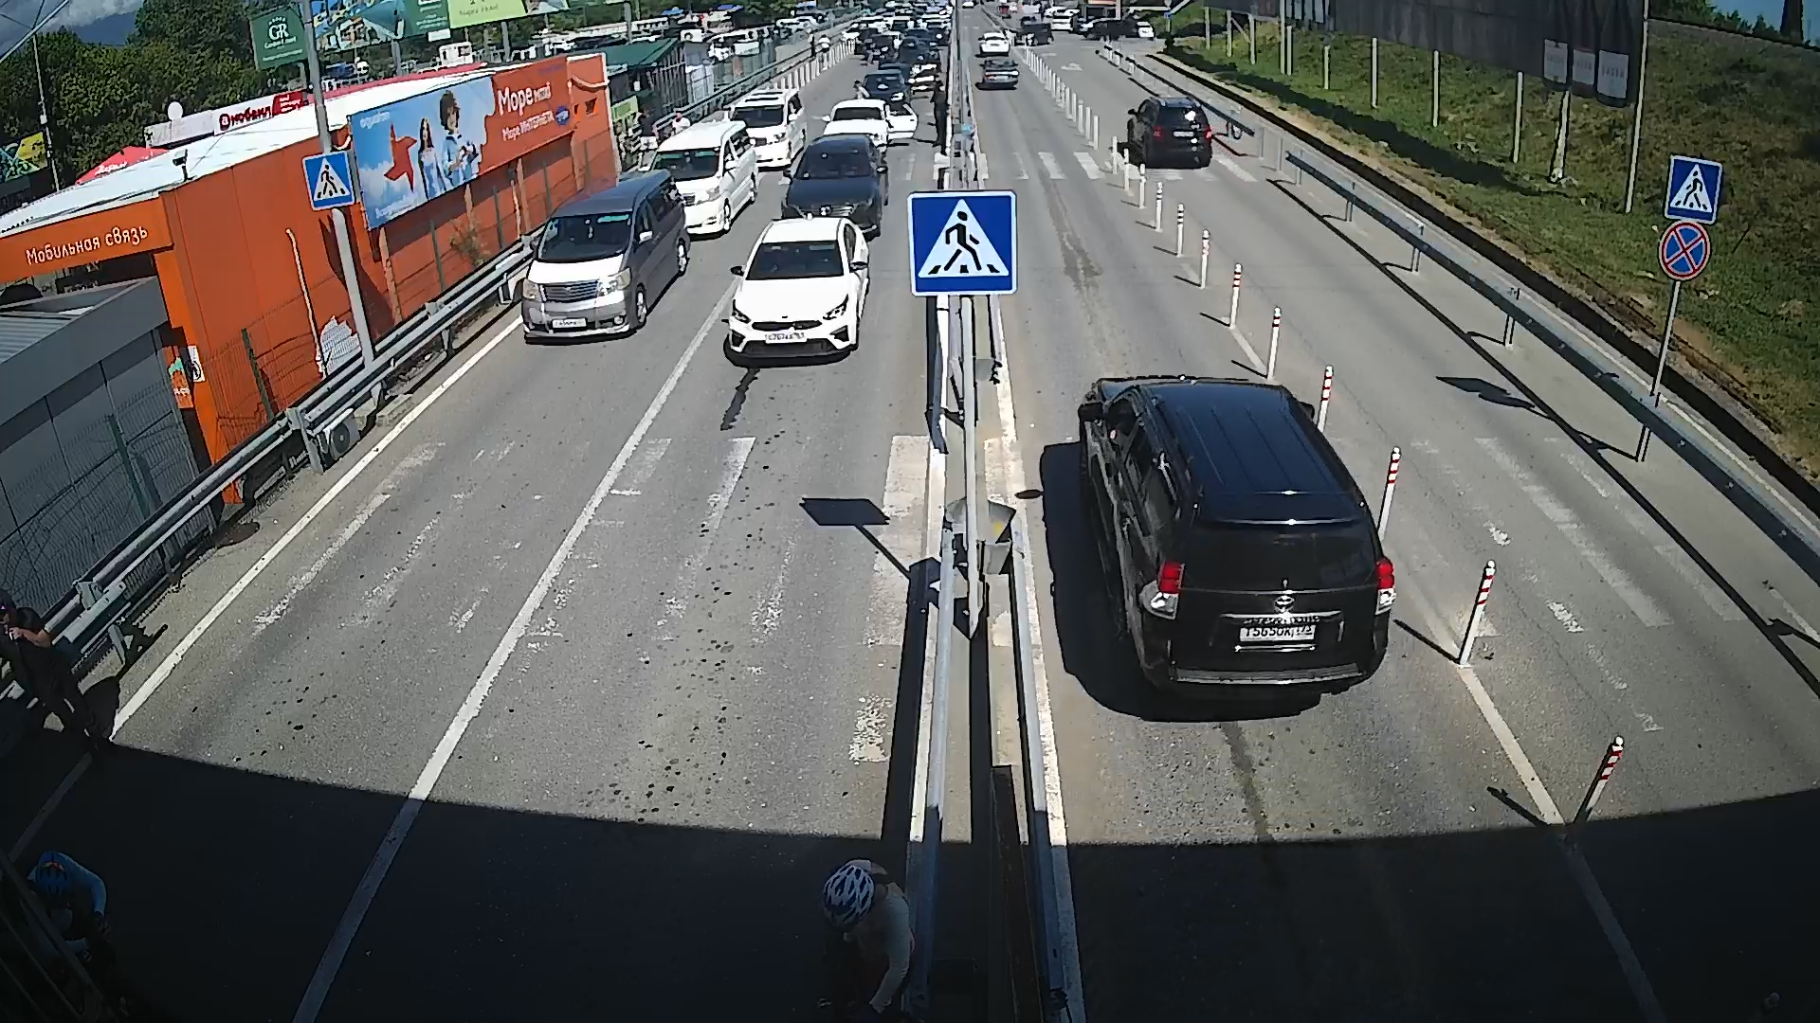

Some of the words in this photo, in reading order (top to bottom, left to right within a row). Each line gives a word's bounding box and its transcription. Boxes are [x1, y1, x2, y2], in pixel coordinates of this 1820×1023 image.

[269, 23, 289, 40] GR
[498, 87, 533, 116] Море
[25, 235, 100, 265] Мобильная
[105, 226, 148, 246] связь
